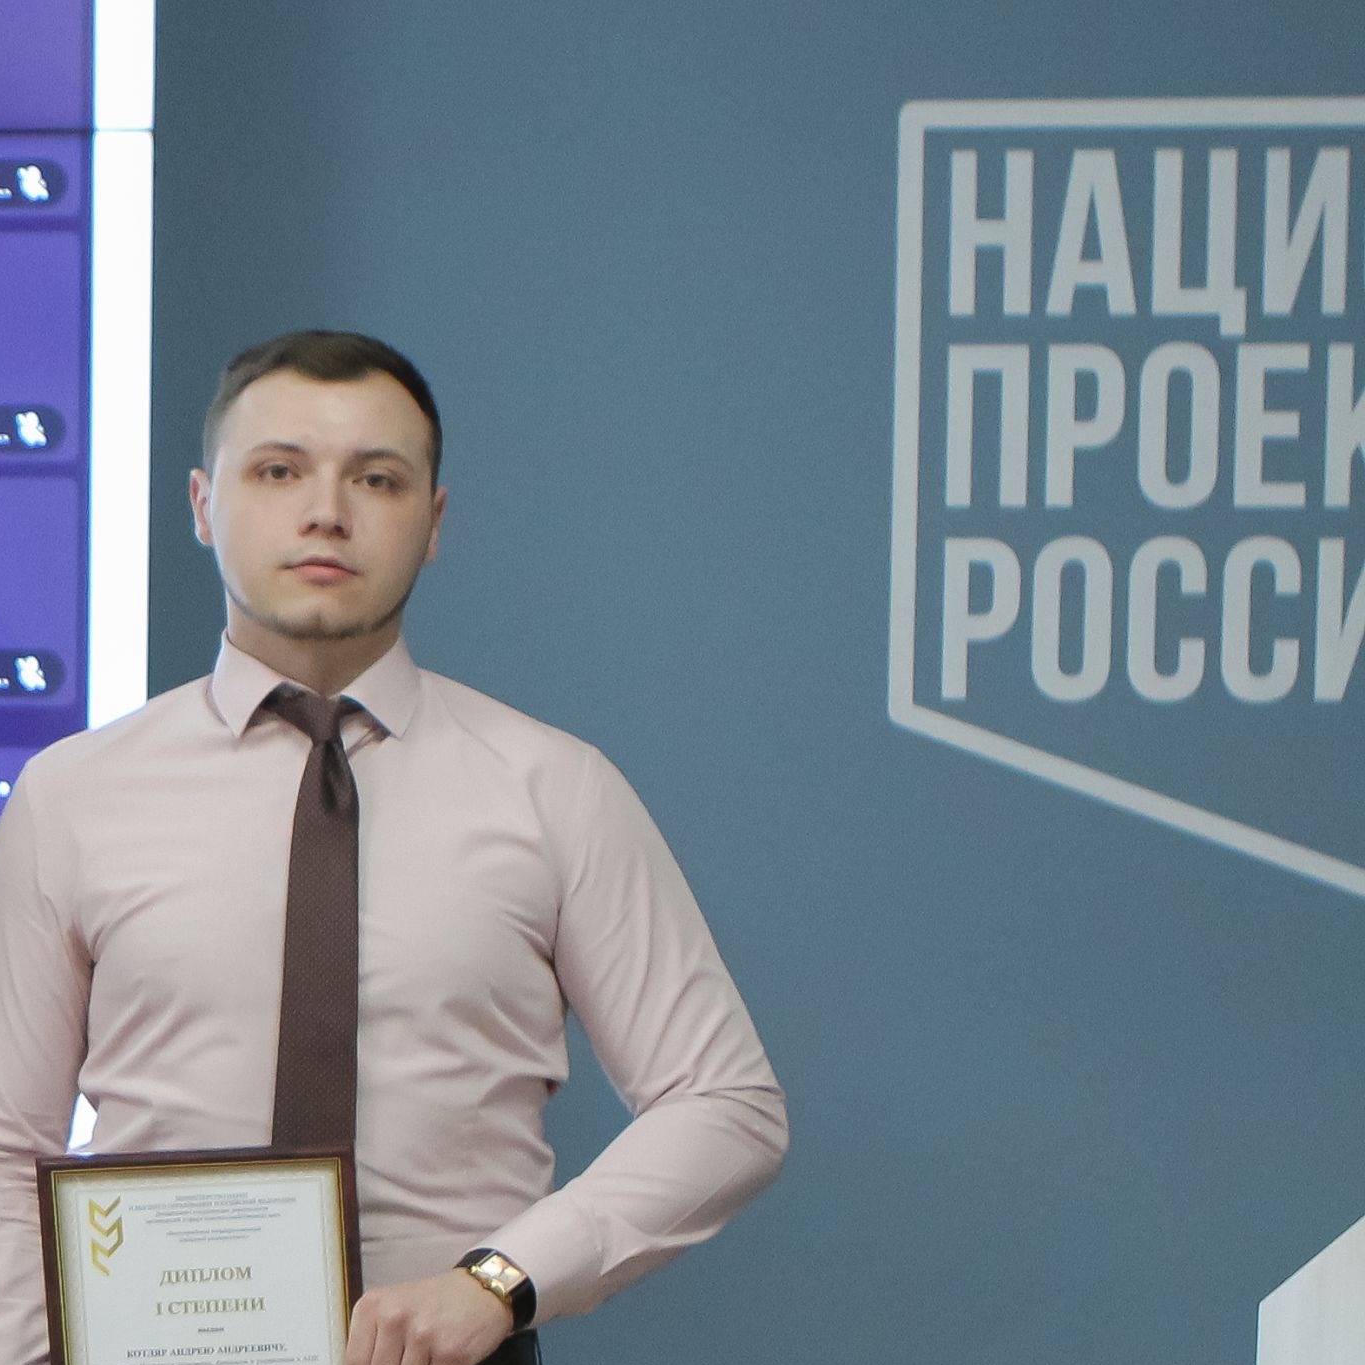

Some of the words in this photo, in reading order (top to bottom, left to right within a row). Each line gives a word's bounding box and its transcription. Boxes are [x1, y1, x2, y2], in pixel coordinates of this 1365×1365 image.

[949, 147, 1365, 336] НАЦИ
[941, 534, 1365, 703] РОССИ
[159, 1266, 253, 1287] ДИПЛОМ
[167, 1297, 266, 1315] СТЕПЕНИ
